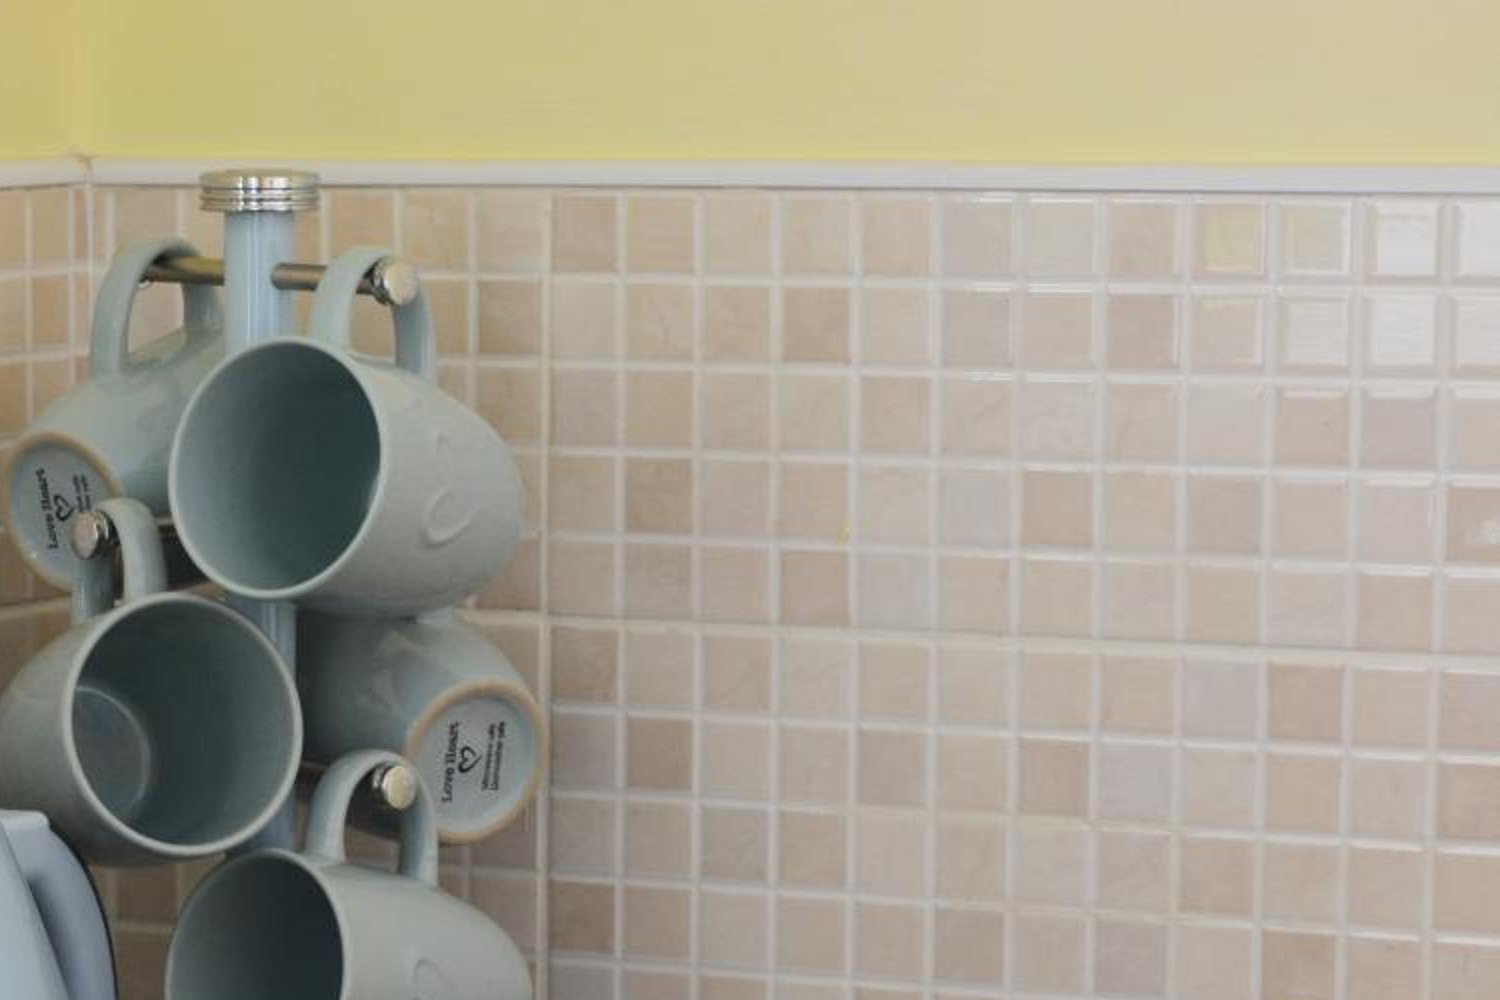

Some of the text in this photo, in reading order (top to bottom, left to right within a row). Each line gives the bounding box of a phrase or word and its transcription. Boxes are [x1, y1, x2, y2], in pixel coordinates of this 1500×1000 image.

[36, 467, 59, 549] Love Heart
[441, 721, 460, 803] Love Heart
